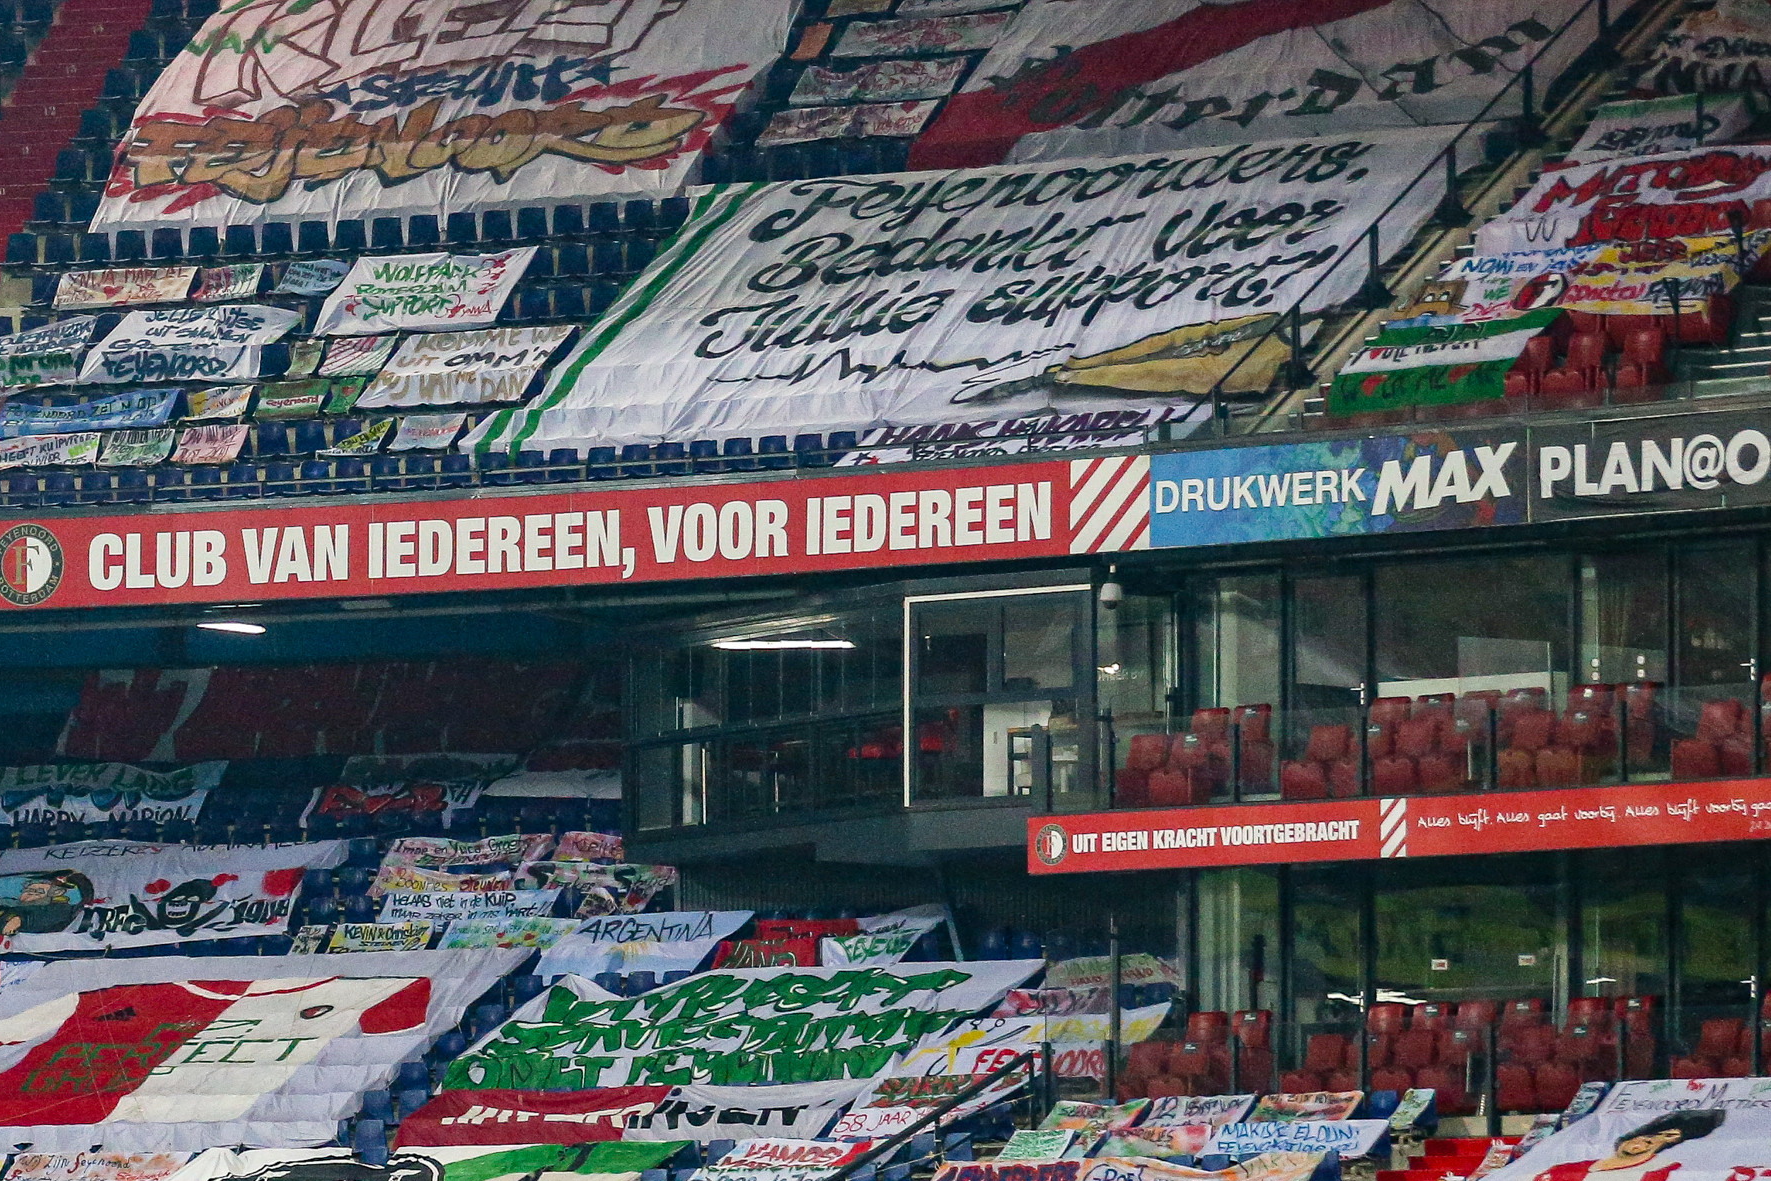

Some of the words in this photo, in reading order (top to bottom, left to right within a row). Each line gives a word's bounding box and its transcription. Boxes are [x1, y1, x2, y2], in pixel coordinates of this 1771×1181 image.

[1156, 468, 1368, 513] DRUKWERK
[1371, 442, 1517, 517] MAX
[1539, 429, 1771, 499] PLAN@O
[88, 530, 226, 591] CLUB
[241, 524, 349, 584] VAN
[368, 509, 636, 579] IEDEREEN,
[647, 499, 789, 563] VOOR
[806, 481, 1052, 555] IEDEREEN
[1073, 833, 1098, 853] UIT
[1102, 830, 1149, 852] EIGEN
[1152, 827, 1218, 849] KRACHT
[1220, 819, 1361, 846] VOORTGEBRACHT
